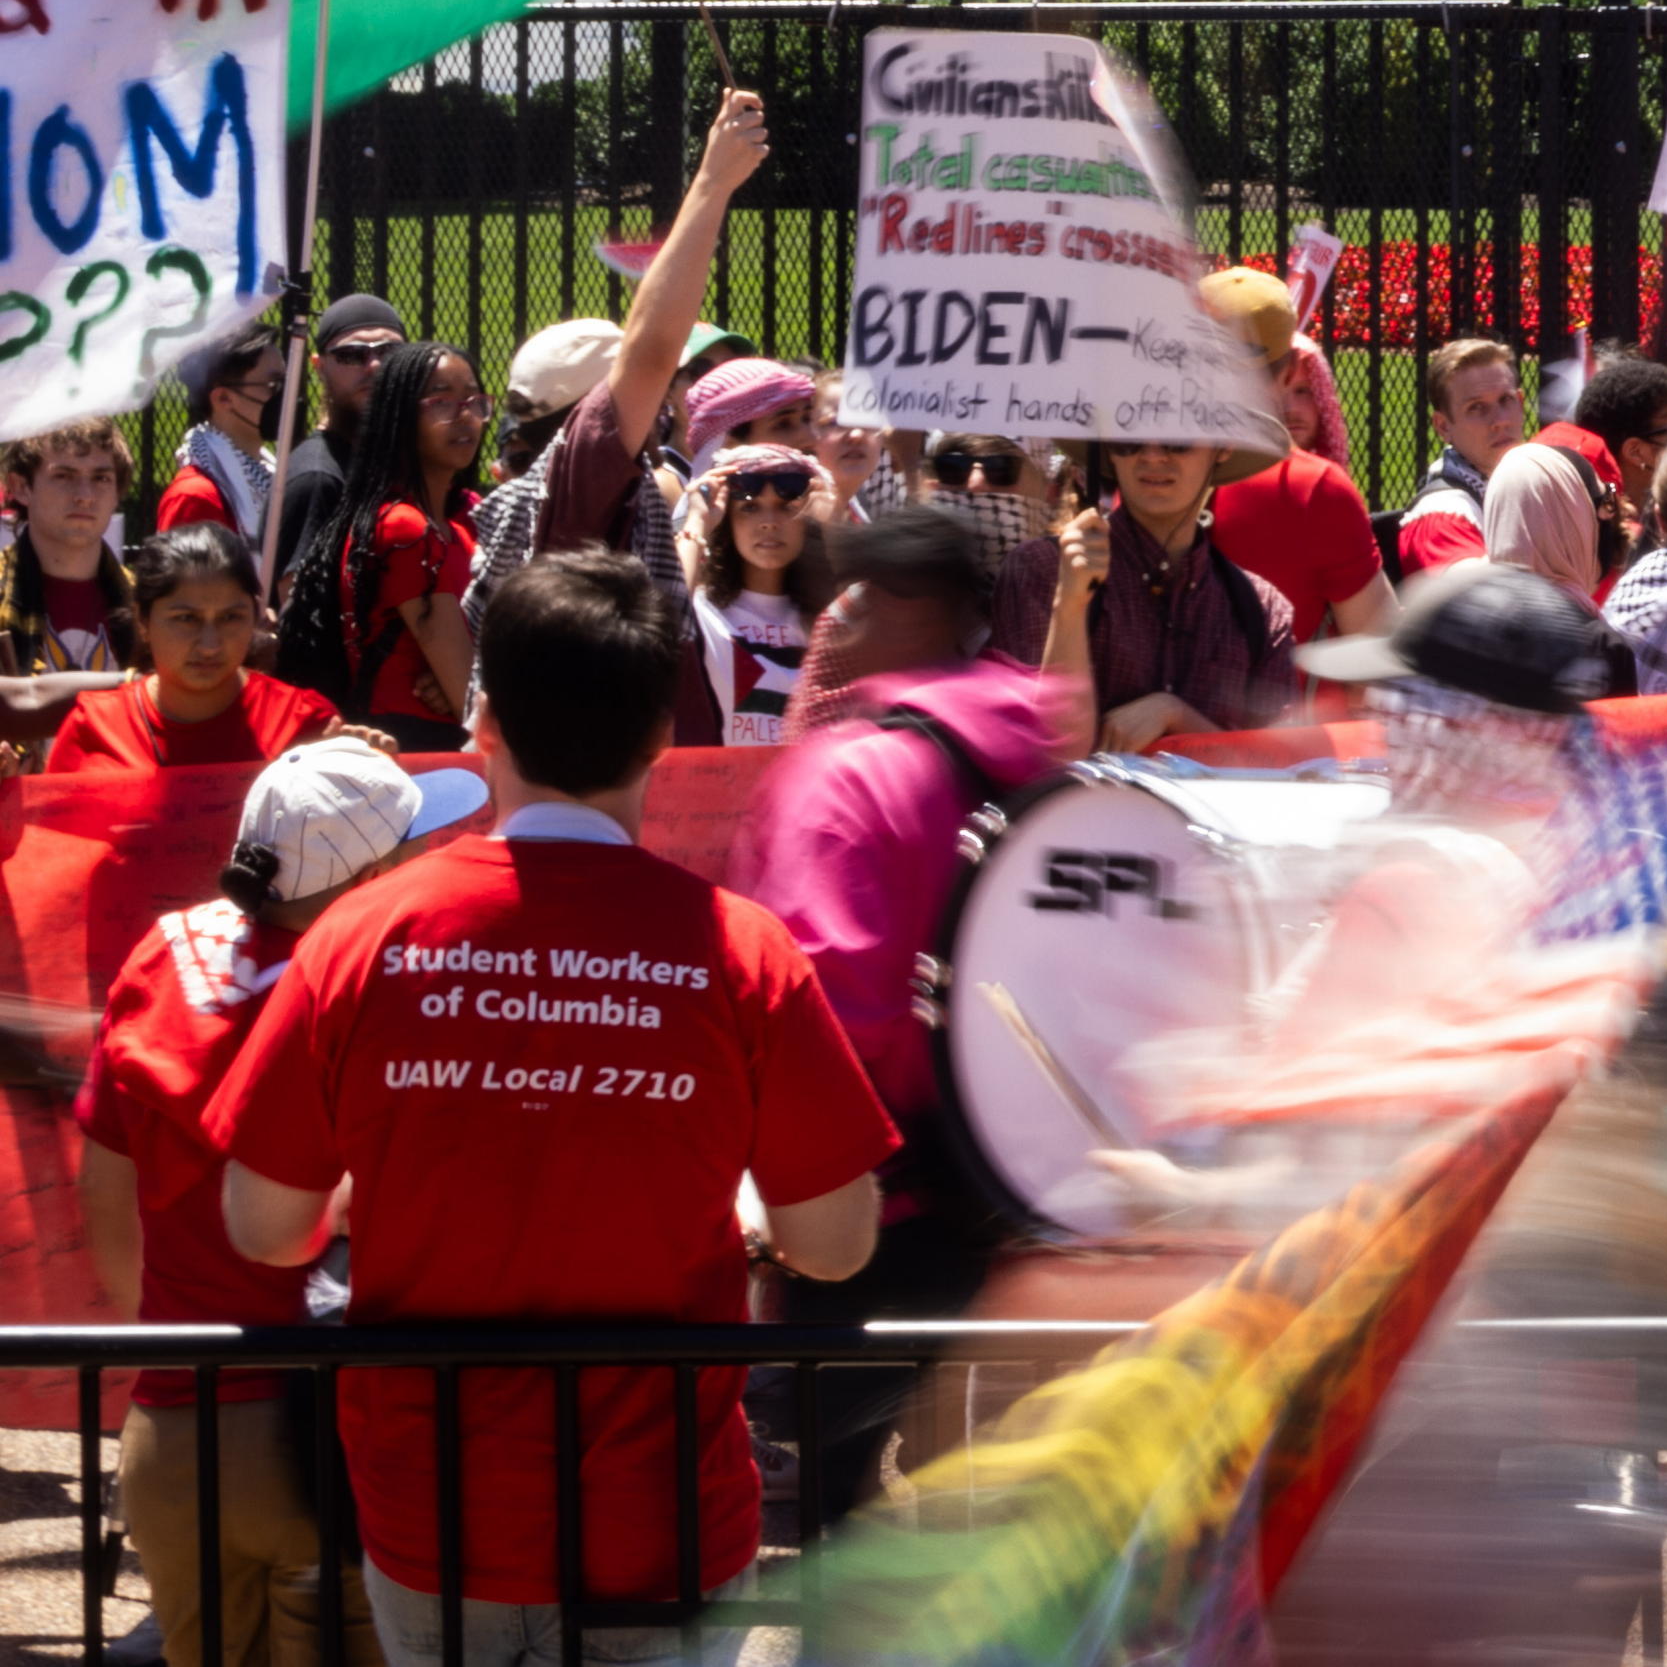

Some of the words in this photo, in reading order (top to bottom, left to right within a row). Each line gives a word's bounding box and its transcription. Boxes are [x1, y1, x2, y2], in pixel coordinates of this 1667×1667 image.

[0, 50, 255, 297] OM
[866, 122, 978, 190] Total
[1005, 383, 1094, 427] hands
[1115, 385, 1170, 430] off
[384, 940, 538, 977] Student
[550, 949, 709, 990] Workers
[421, 986, 464, 1018] of
[476, 989, 662, 1029] Columbia
[385, 1060, 473, 1090] UAW
[482, 1062, 584, 1093] Local
[593, 1067, 697, 1102] 2710
